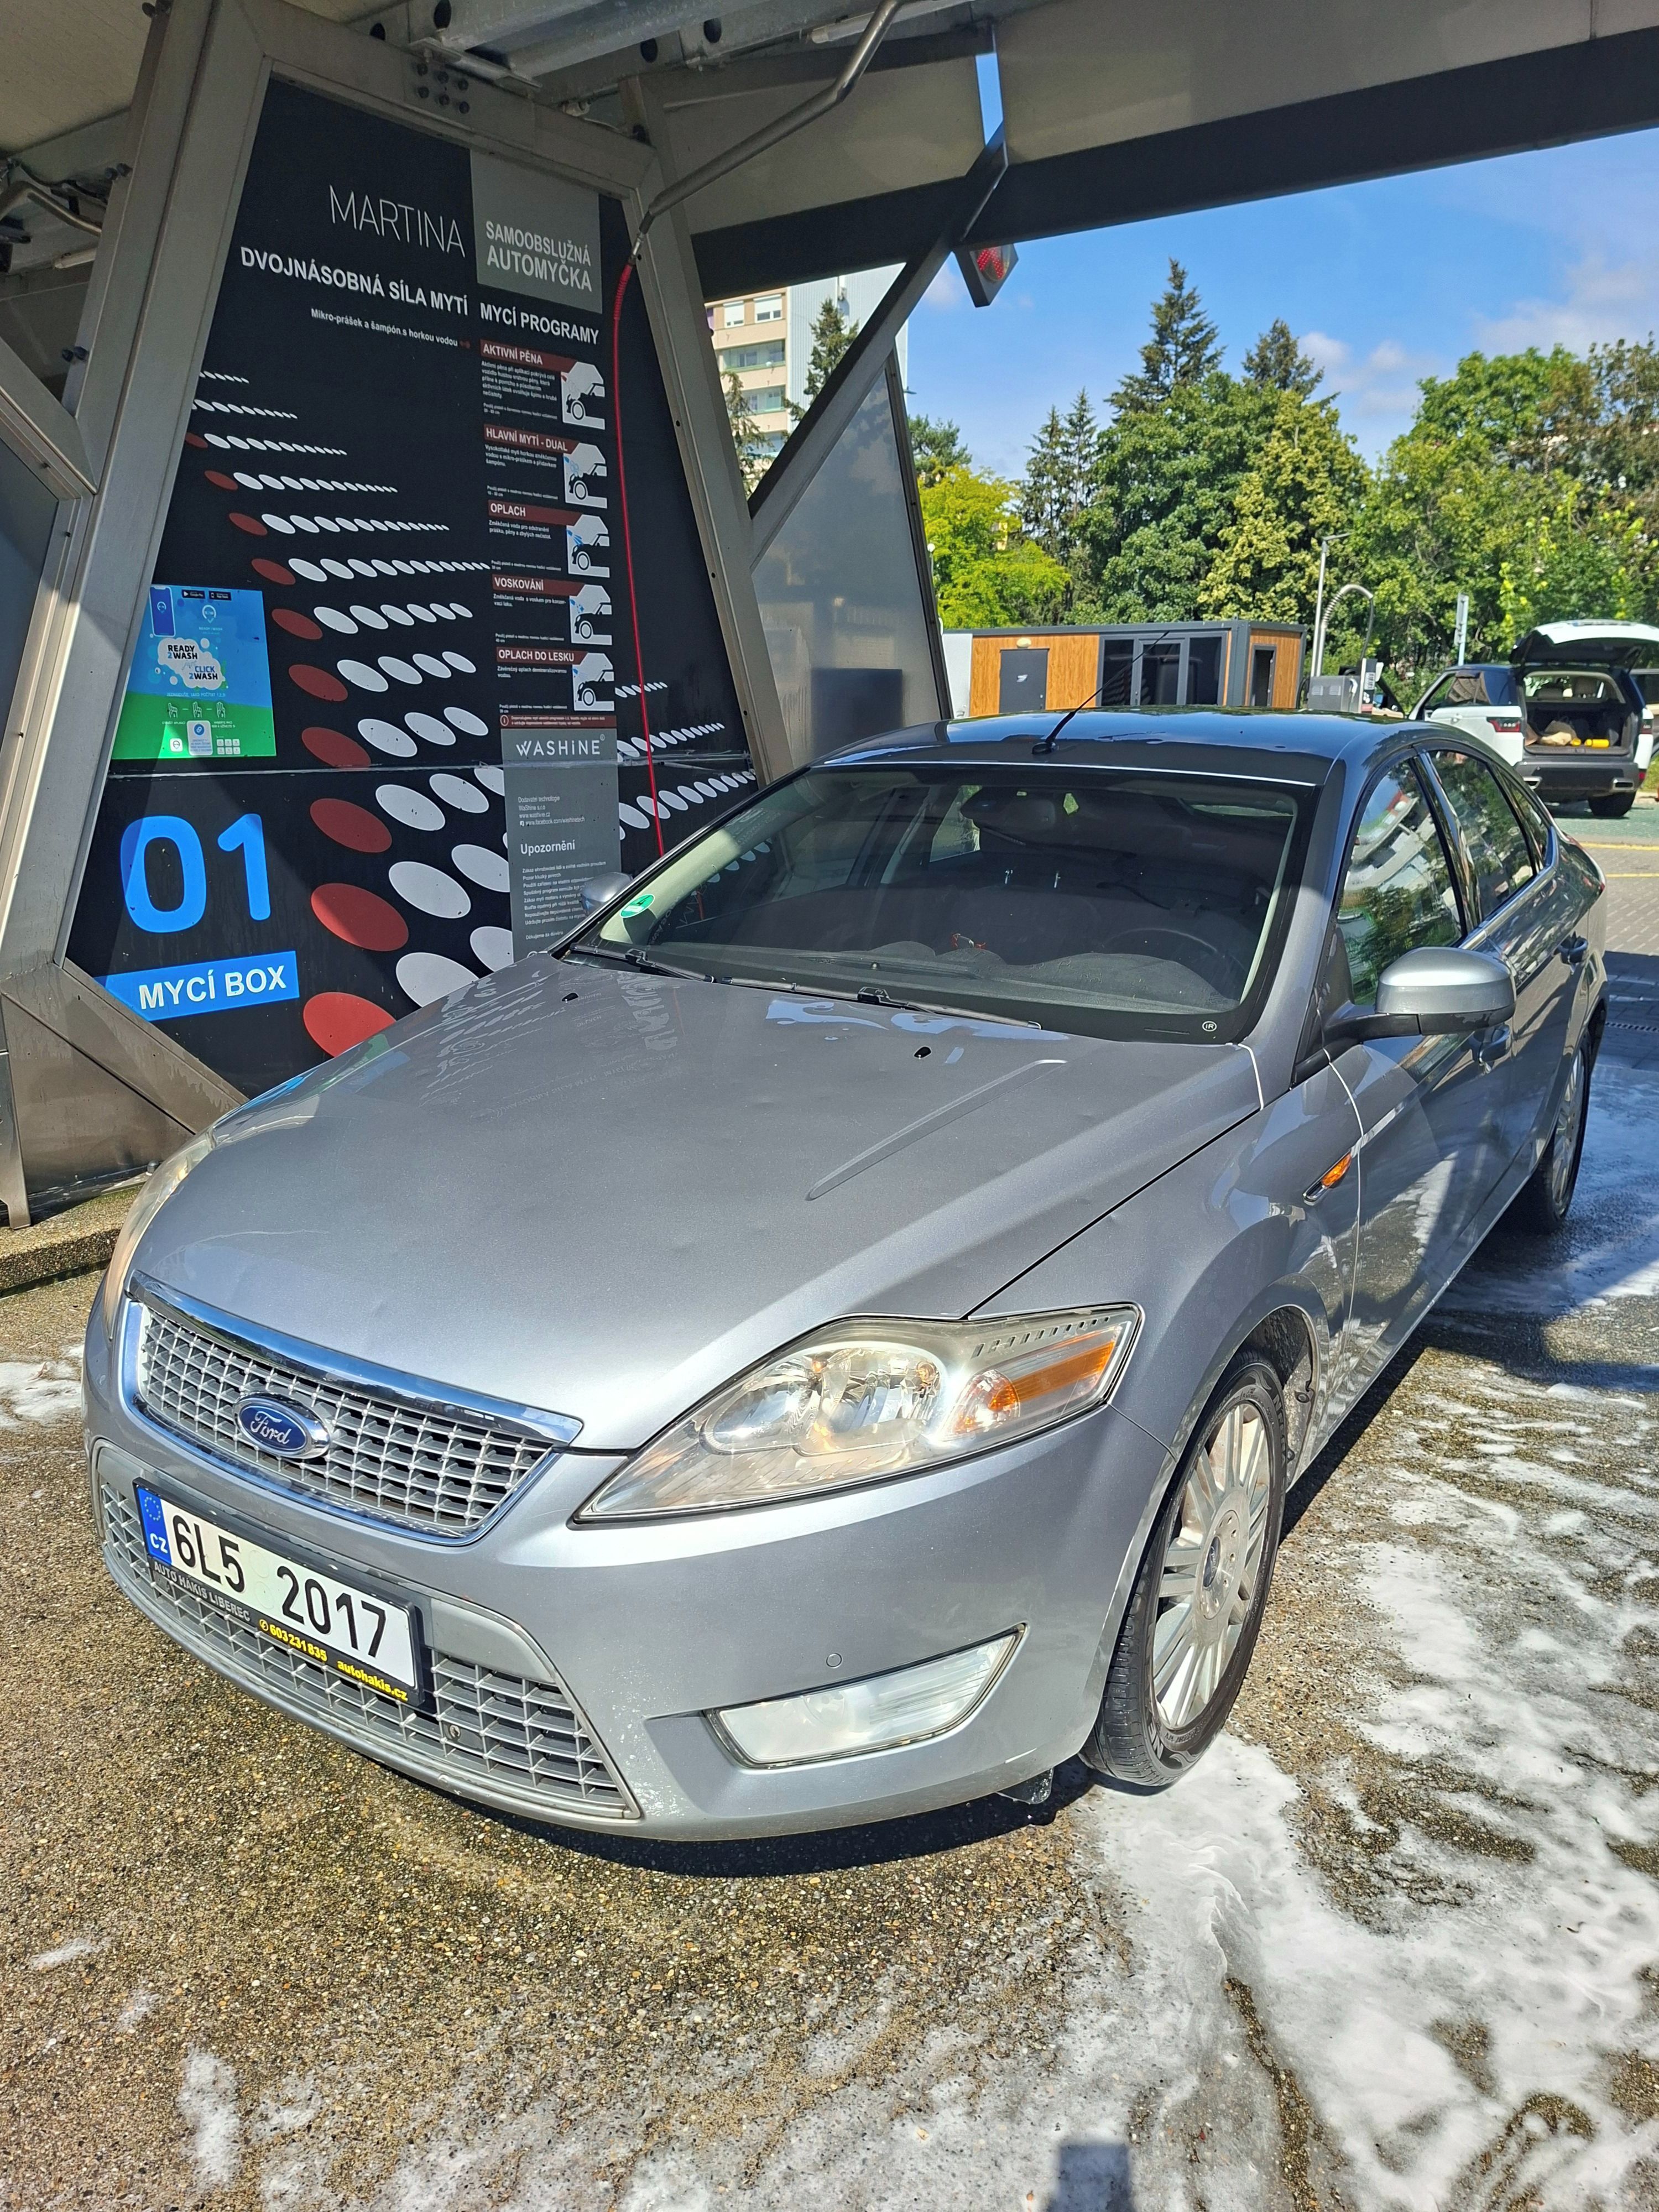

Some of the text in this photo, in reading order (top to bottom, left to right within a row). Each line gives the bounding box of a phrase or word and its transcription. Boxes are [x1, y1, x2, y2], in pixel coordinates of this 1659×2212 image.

[330, 185, 466, 258] MARTINA
[486, 221, 591, 266] SAMOOBSLUŽNÁ
[241, 247, 468, 315] DVOJNÁSOBNÁ SÍLA MYTÍ
[486, 244, 592, 292] AUTOMYČKA
[311, 308, 362, 328] Mikro-prášek
[371, 321, 401, 335] šampón
[409, 328, 434, 341] horkou
[436, 335, 458, 347] vodou
[481, 302, 599, 345] MYCÍ PROGRAMY
[483, 343, 543, 365] AKTIVNÍ PĚNA
[486, 427, 518, 442] HLAVNÍ
[519, 434, 539, 446] MYTÍ
[545, 438, 568, 451] DUAL
[491, 503, 526, 518] OPLACH
[494, 576, 544, 591] VOSKOVÁNÍ
[499, 649, 575, 662] OPLACH DO LESKU
[520, 839, 575, 856] Upozornění
[120, 813, 271, 933] 01
[139, 965, 286, 1010] MYCÍ BOX
[250, 1410, 291, 1446] Ford
[150, 1532, 168, 1554] CZ
[154, 1561, 178, 1583] AUTO
[208, 1591, 251, 1623] LIBEREC
[172, 1514, 387, 1658] 6L5 2017
[337, 1660, 408, 1702] autohakis.cz
